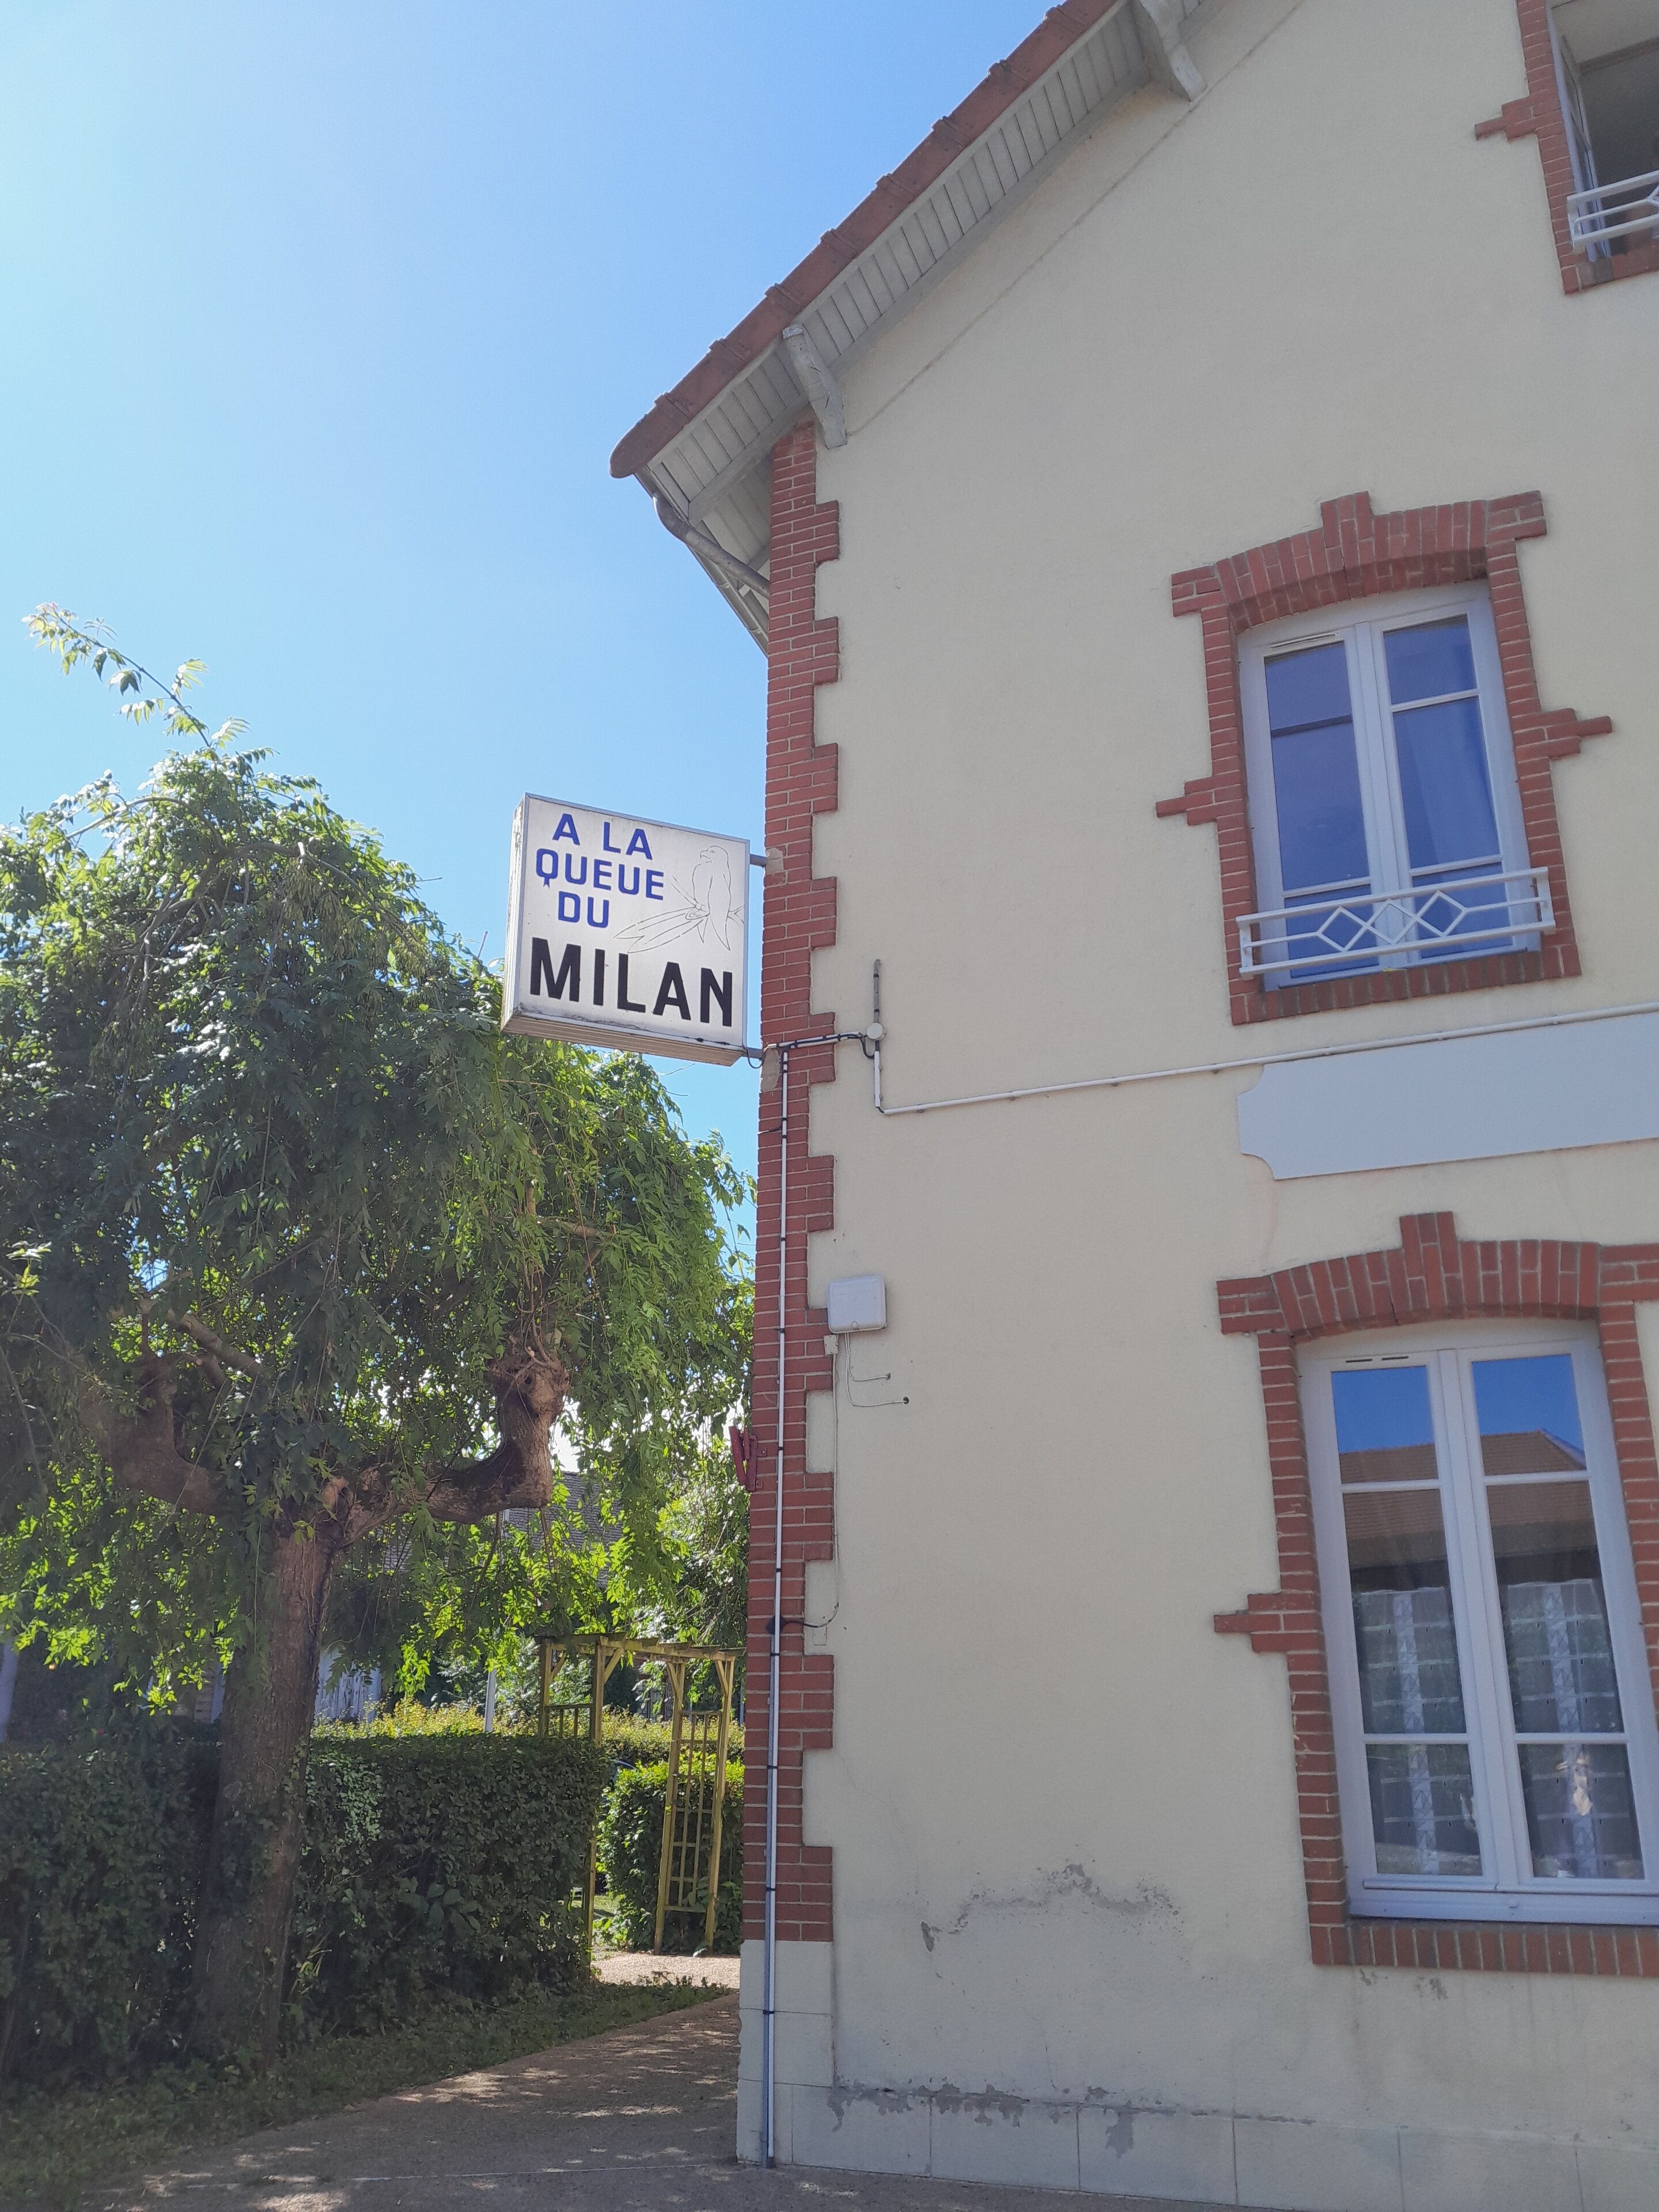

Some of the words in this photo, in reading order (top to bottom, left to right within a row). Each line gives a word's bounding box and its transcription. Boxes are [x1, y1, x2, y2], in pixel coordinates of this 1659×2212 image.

[552, 813, 581, 846] A
[603, 821, 653, 861] LA
[536, 848, 664, 901] QUEUE
[558, 891, 609, 929] DU
[529, 937, 733, 1028] MILAN
